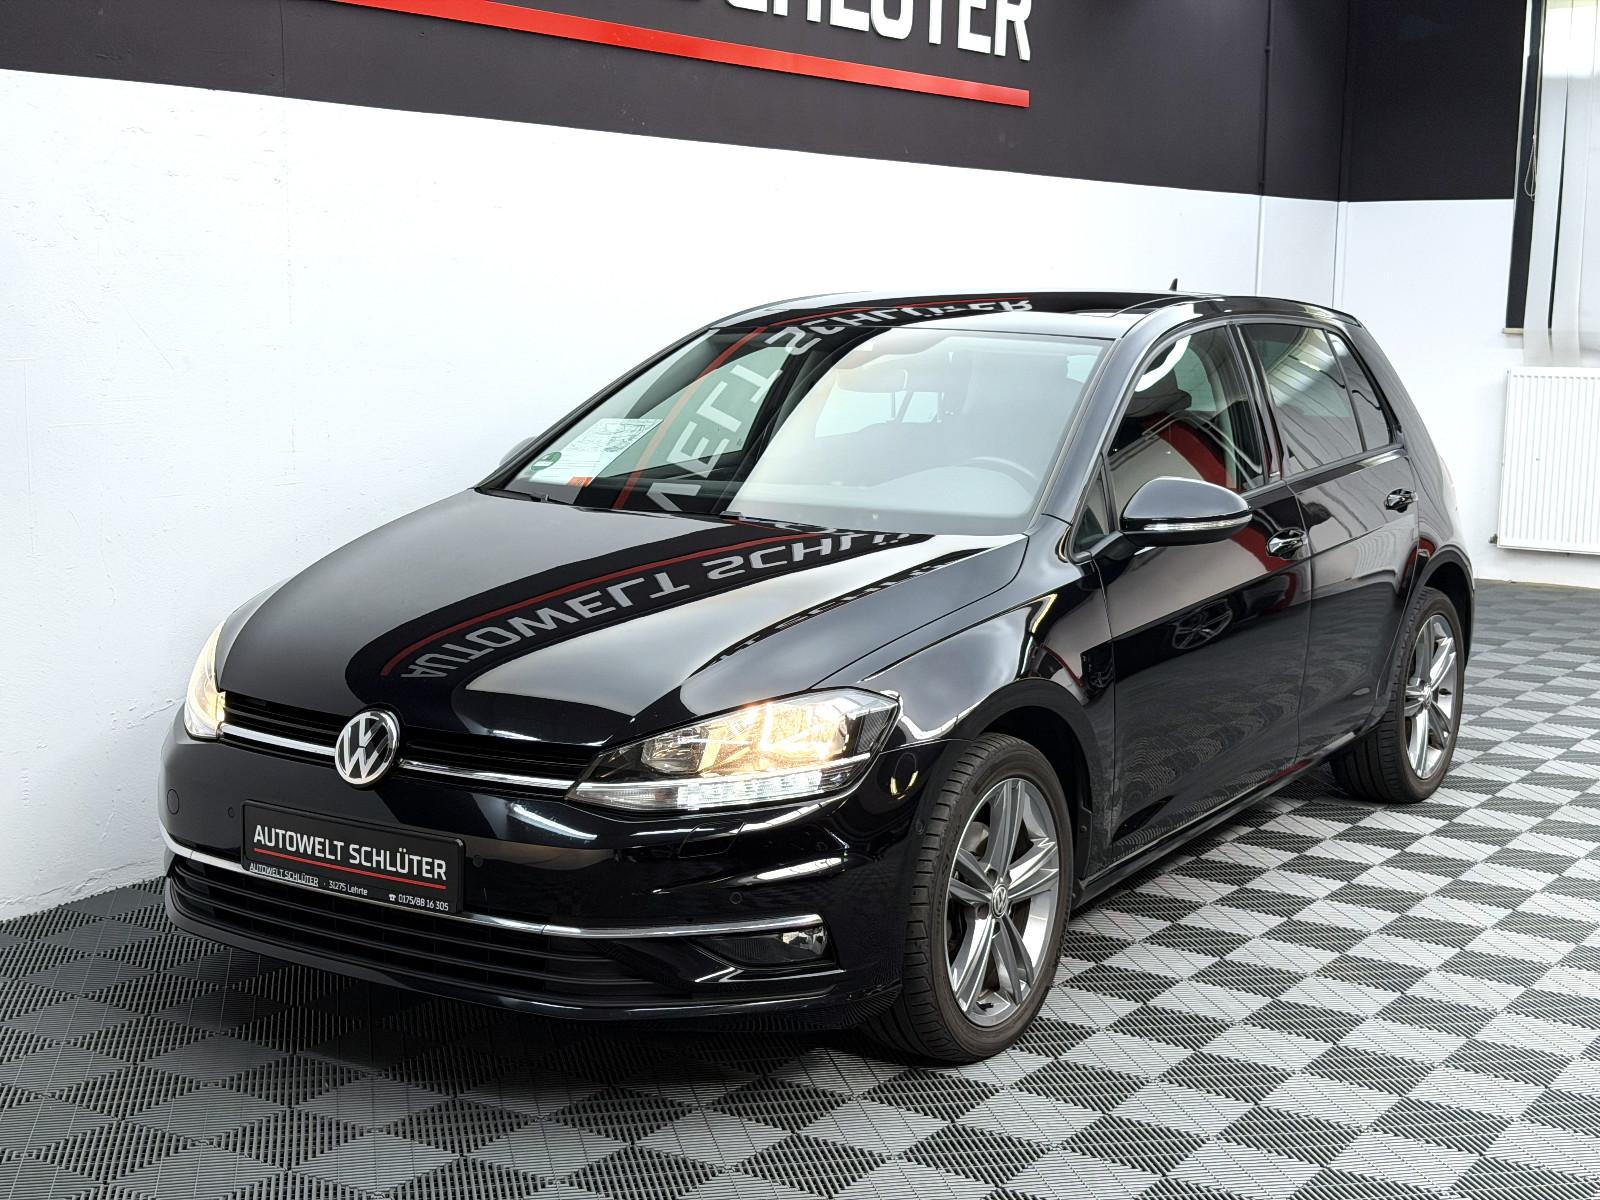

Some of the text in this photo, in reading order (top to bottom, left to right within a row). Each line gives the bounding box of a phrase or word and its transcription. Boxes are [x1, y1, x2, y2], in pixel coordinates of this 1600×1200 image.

[253, 824, 447, 881] AUTOWELT SCHLÜTER
[249, 862, 449, 911] AUTOWELT SCHLÜTER 31275 Lehrte 0175/88 16 305
